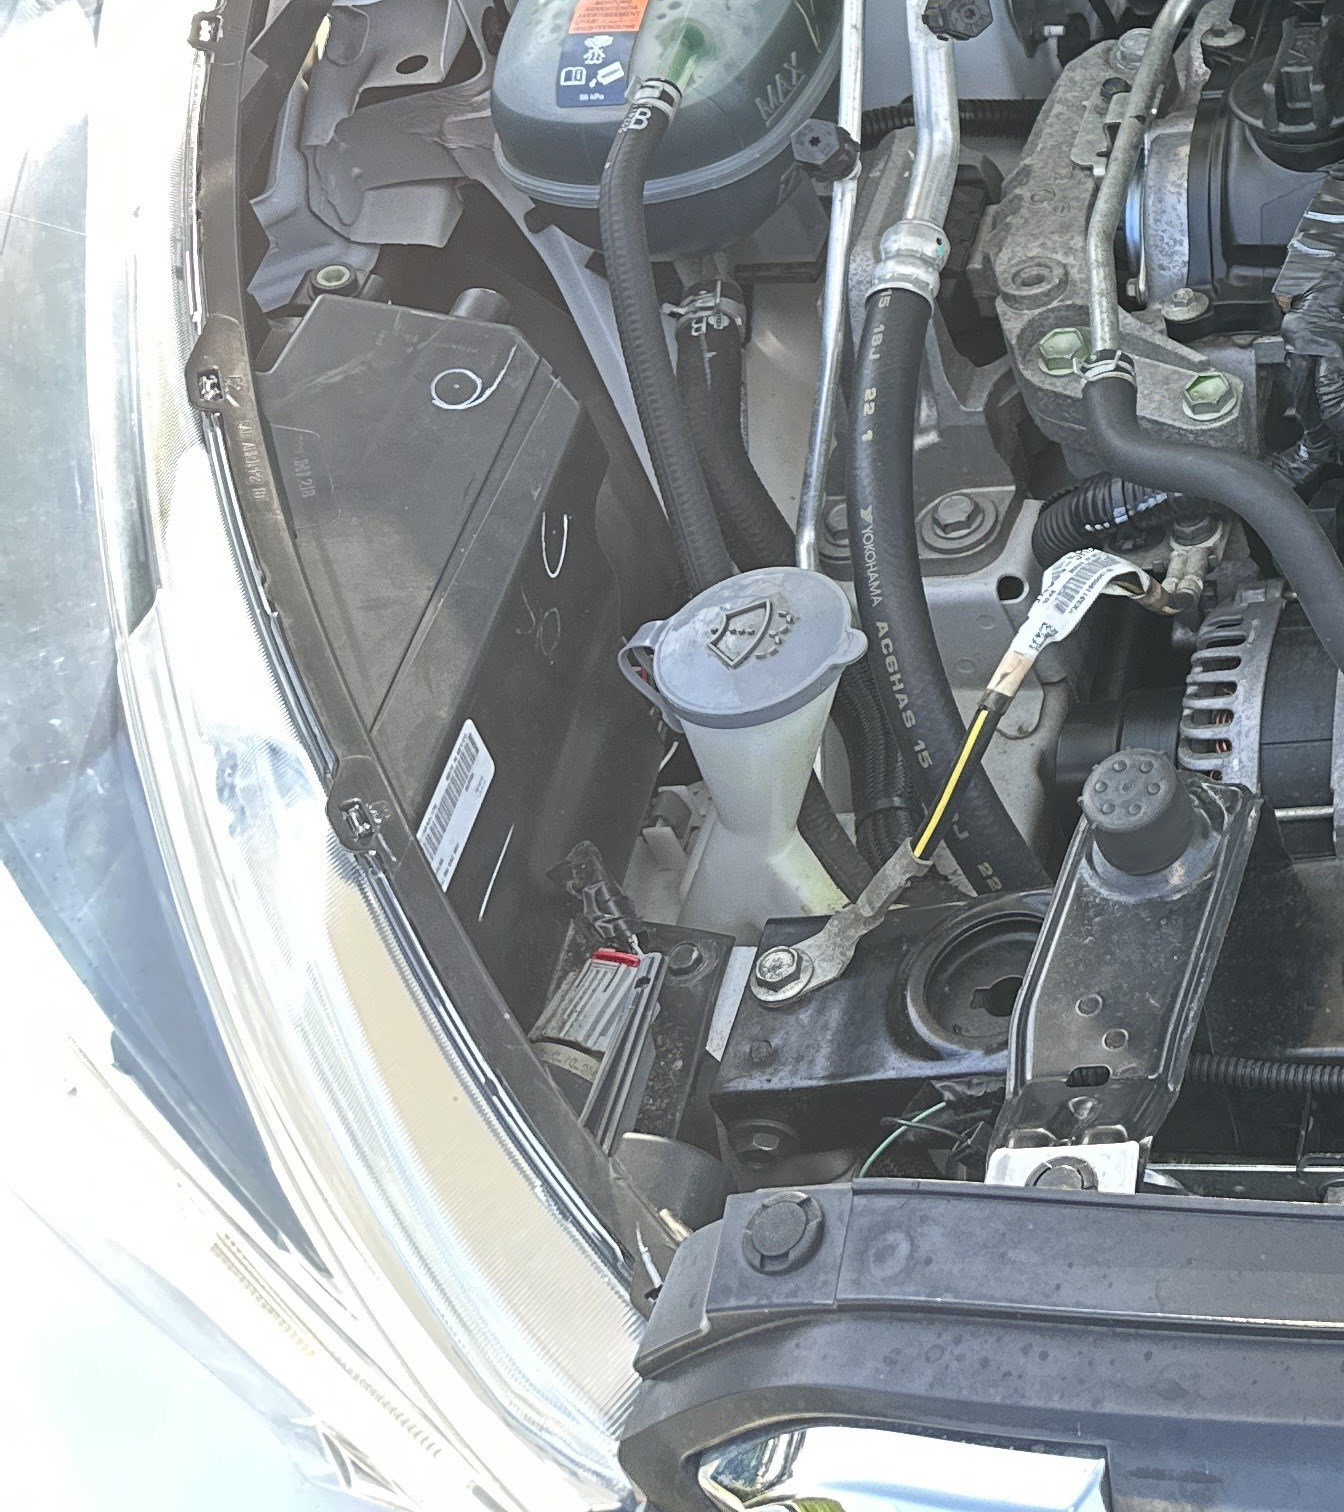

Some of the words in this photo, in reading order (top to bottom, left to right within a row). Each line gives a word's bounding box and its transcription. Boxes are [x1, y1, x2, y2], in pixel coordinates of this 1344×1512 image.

[754, 51, 799, 121] MAX
[862, 387, 876, 416] 22
[860, 523, 884, 608] YOKOHAMA
[875, 620, 916, 729] AC6HAS
[914, 738, 933, 769] 15
